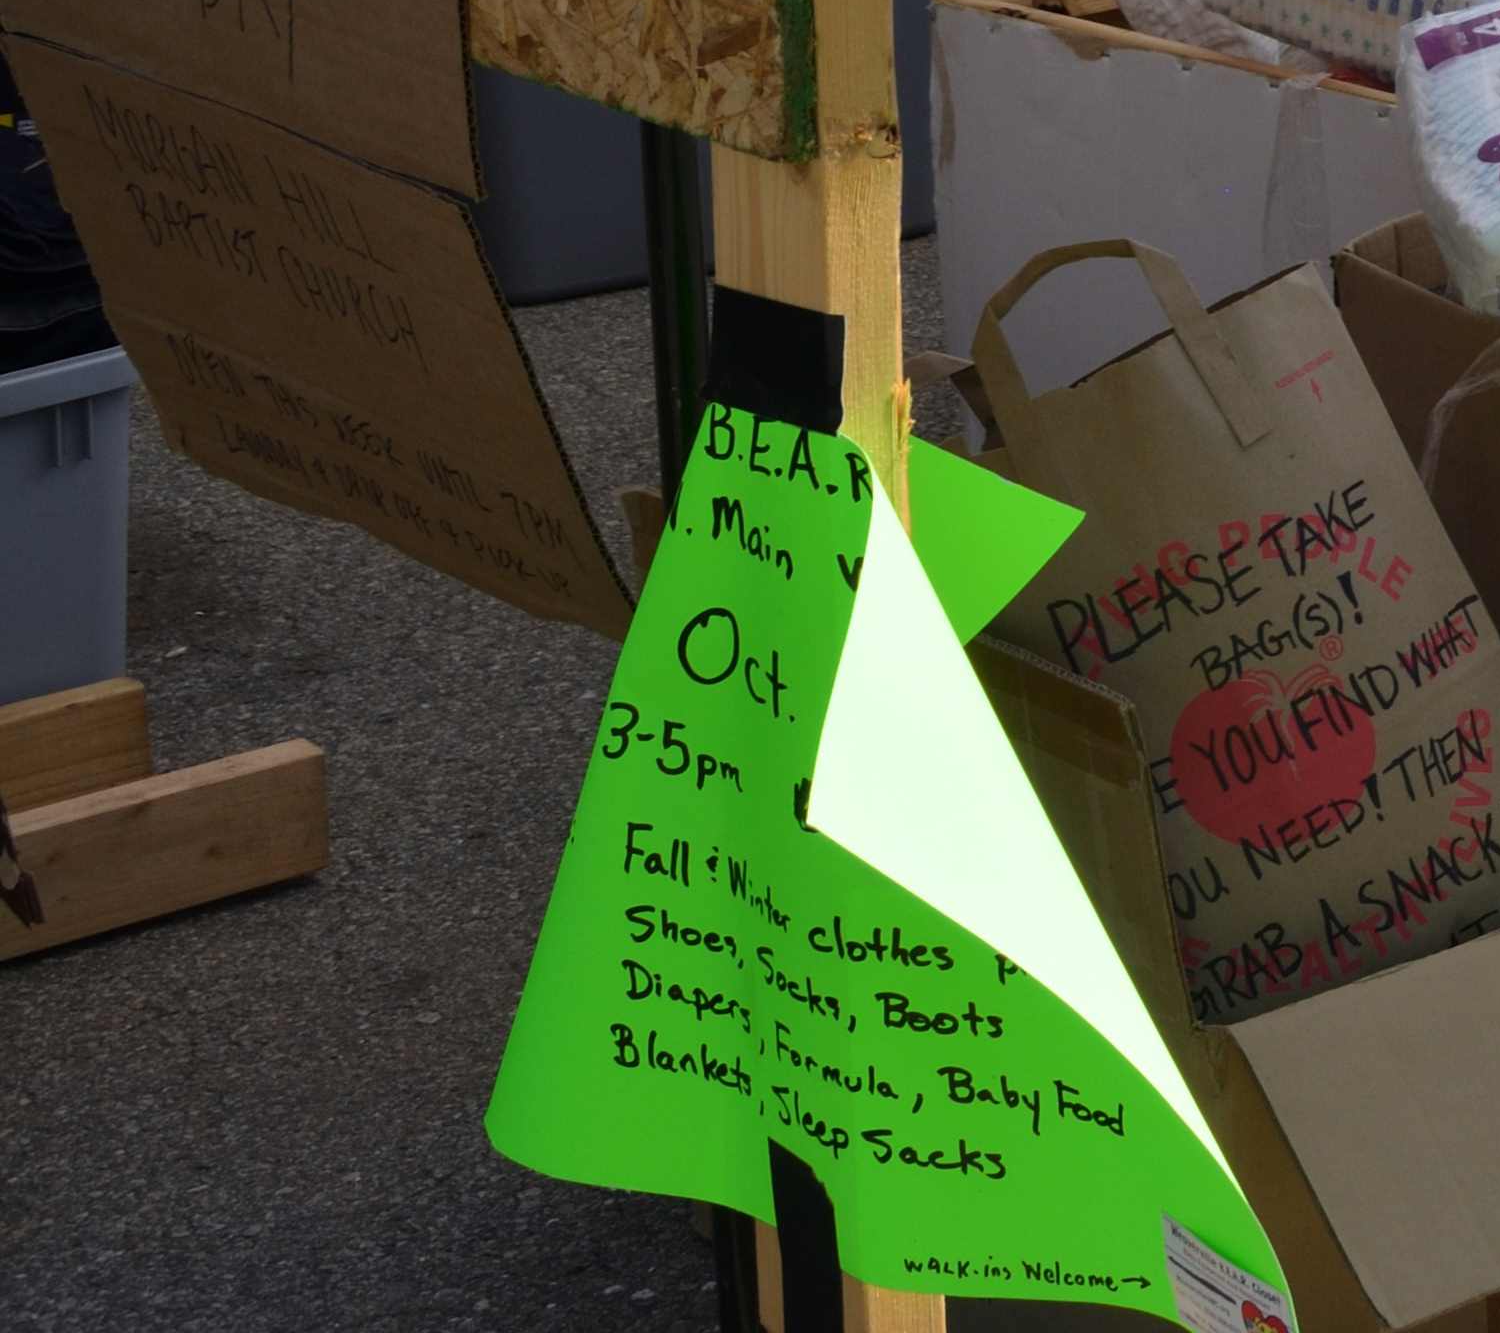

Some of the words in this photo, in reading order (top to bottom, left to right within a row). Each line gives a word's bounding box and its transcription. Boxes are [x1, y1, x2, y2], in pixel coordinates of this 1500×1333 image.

[263, 153, 410, 275] HILL
[711, 493, 794, 580] Main
[1046, 539, 1263, 681] PLEASE
[1256, 479, 1376, 579] TAKE
[678, 606, 798, 725] Oct.
[1189, 570, 1367, 692] BAG(S)!
[602, 700, 744, 794] 3-5pm
[1189, 708, 1297, 794] YOU
[1287, 660, 1401, 753] FIND
[1395, 593, 1481, 690] WHAT
[1169, 855, 1230, 921] OU
[1239, 771, 1388, 882] NEED!
[1382, 708, 1487, 803] THEN
[624, 821, 690, 882] Fall
[727, 856, 791, 933] Winter
[806, 925, 956, 976] clothes
[1318, 898, 1354, 958] A
[624, 903, 745, 973] Shoes,
[754, 946, 857, 1039] Socks,
[876, 988, 1006, 1041] Boots
[772, 1081, 850, 1156] Sleep
[872, 1123, 1009, 1182] Sacks
[774, 1028, 924, 1115] Formula,
[937, 1063, 1042, 1132] Baby
[1054, 1076, 1128, 1139] Food
[1019, 1260, 1119, 1292] Welcome
